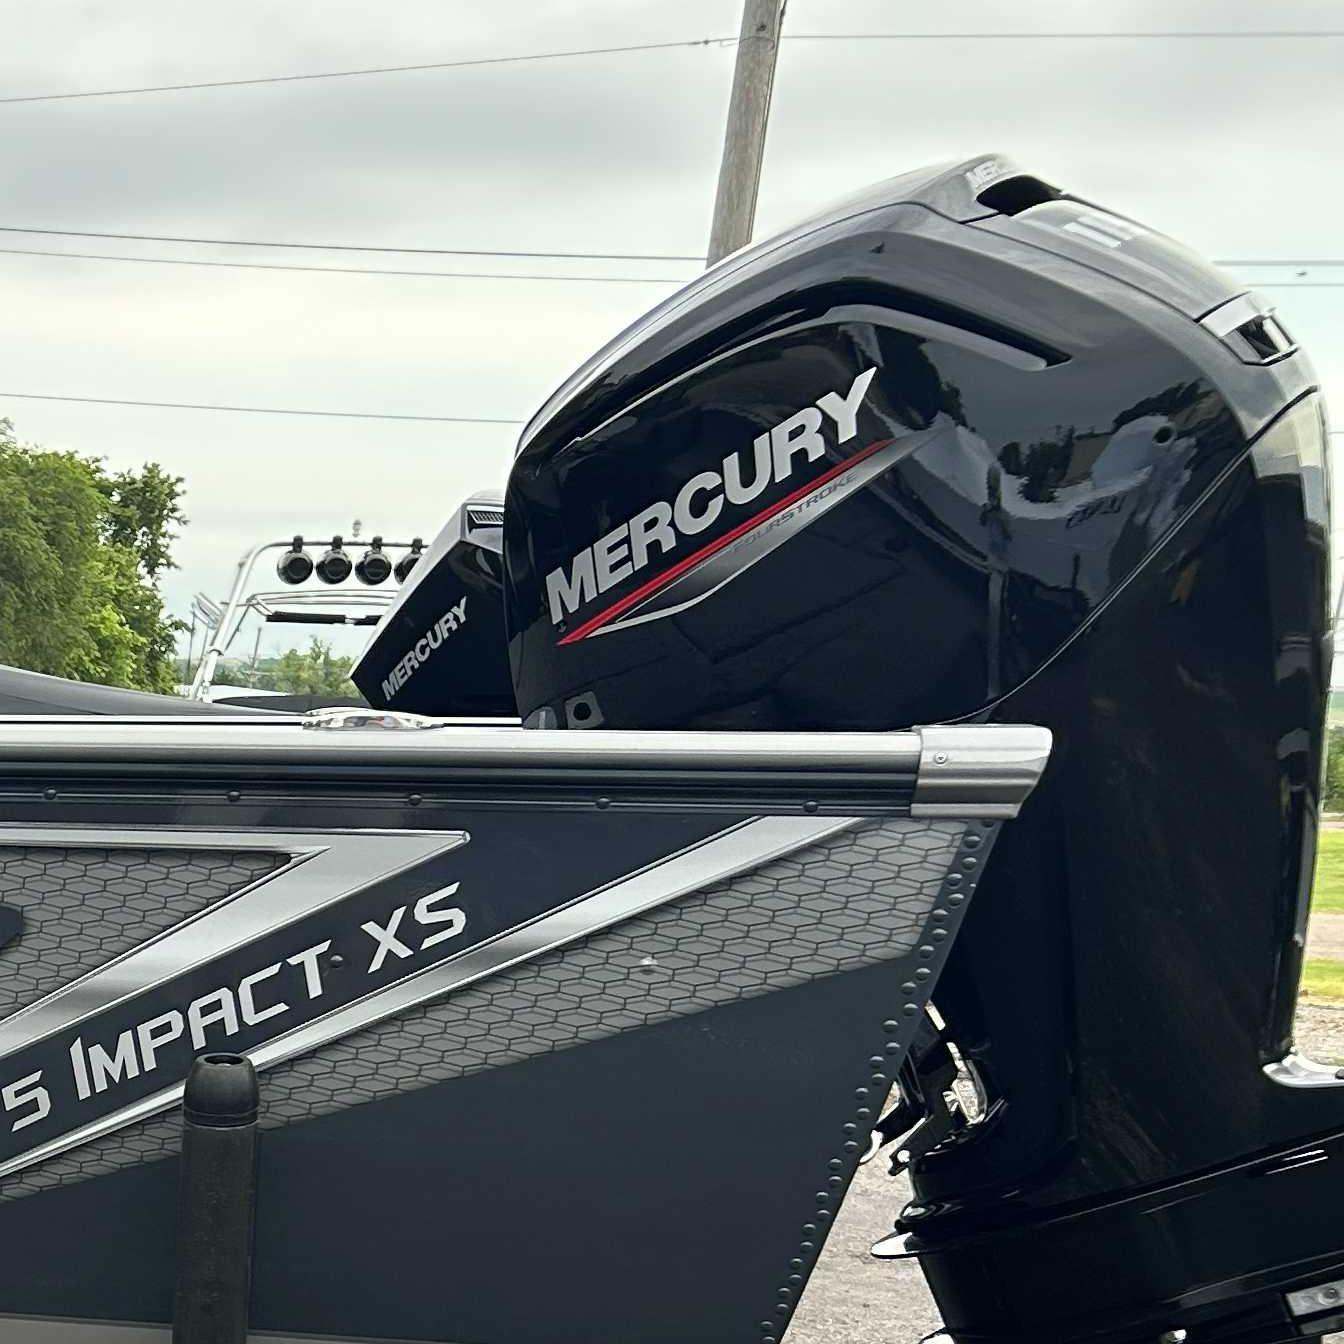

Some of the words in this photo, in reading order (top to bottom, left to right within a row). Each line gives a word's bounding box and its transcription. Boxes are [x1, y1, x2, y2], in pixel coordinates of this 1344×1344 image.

[545, 366, 878, 627] MERCURY
[730, 471, 859, 554] FOURSTROKE
[381, 596, 470, 702] MERCURY
[68, 939, 332, 1101] IMPACT
[359, 880, 468, 974] XS
